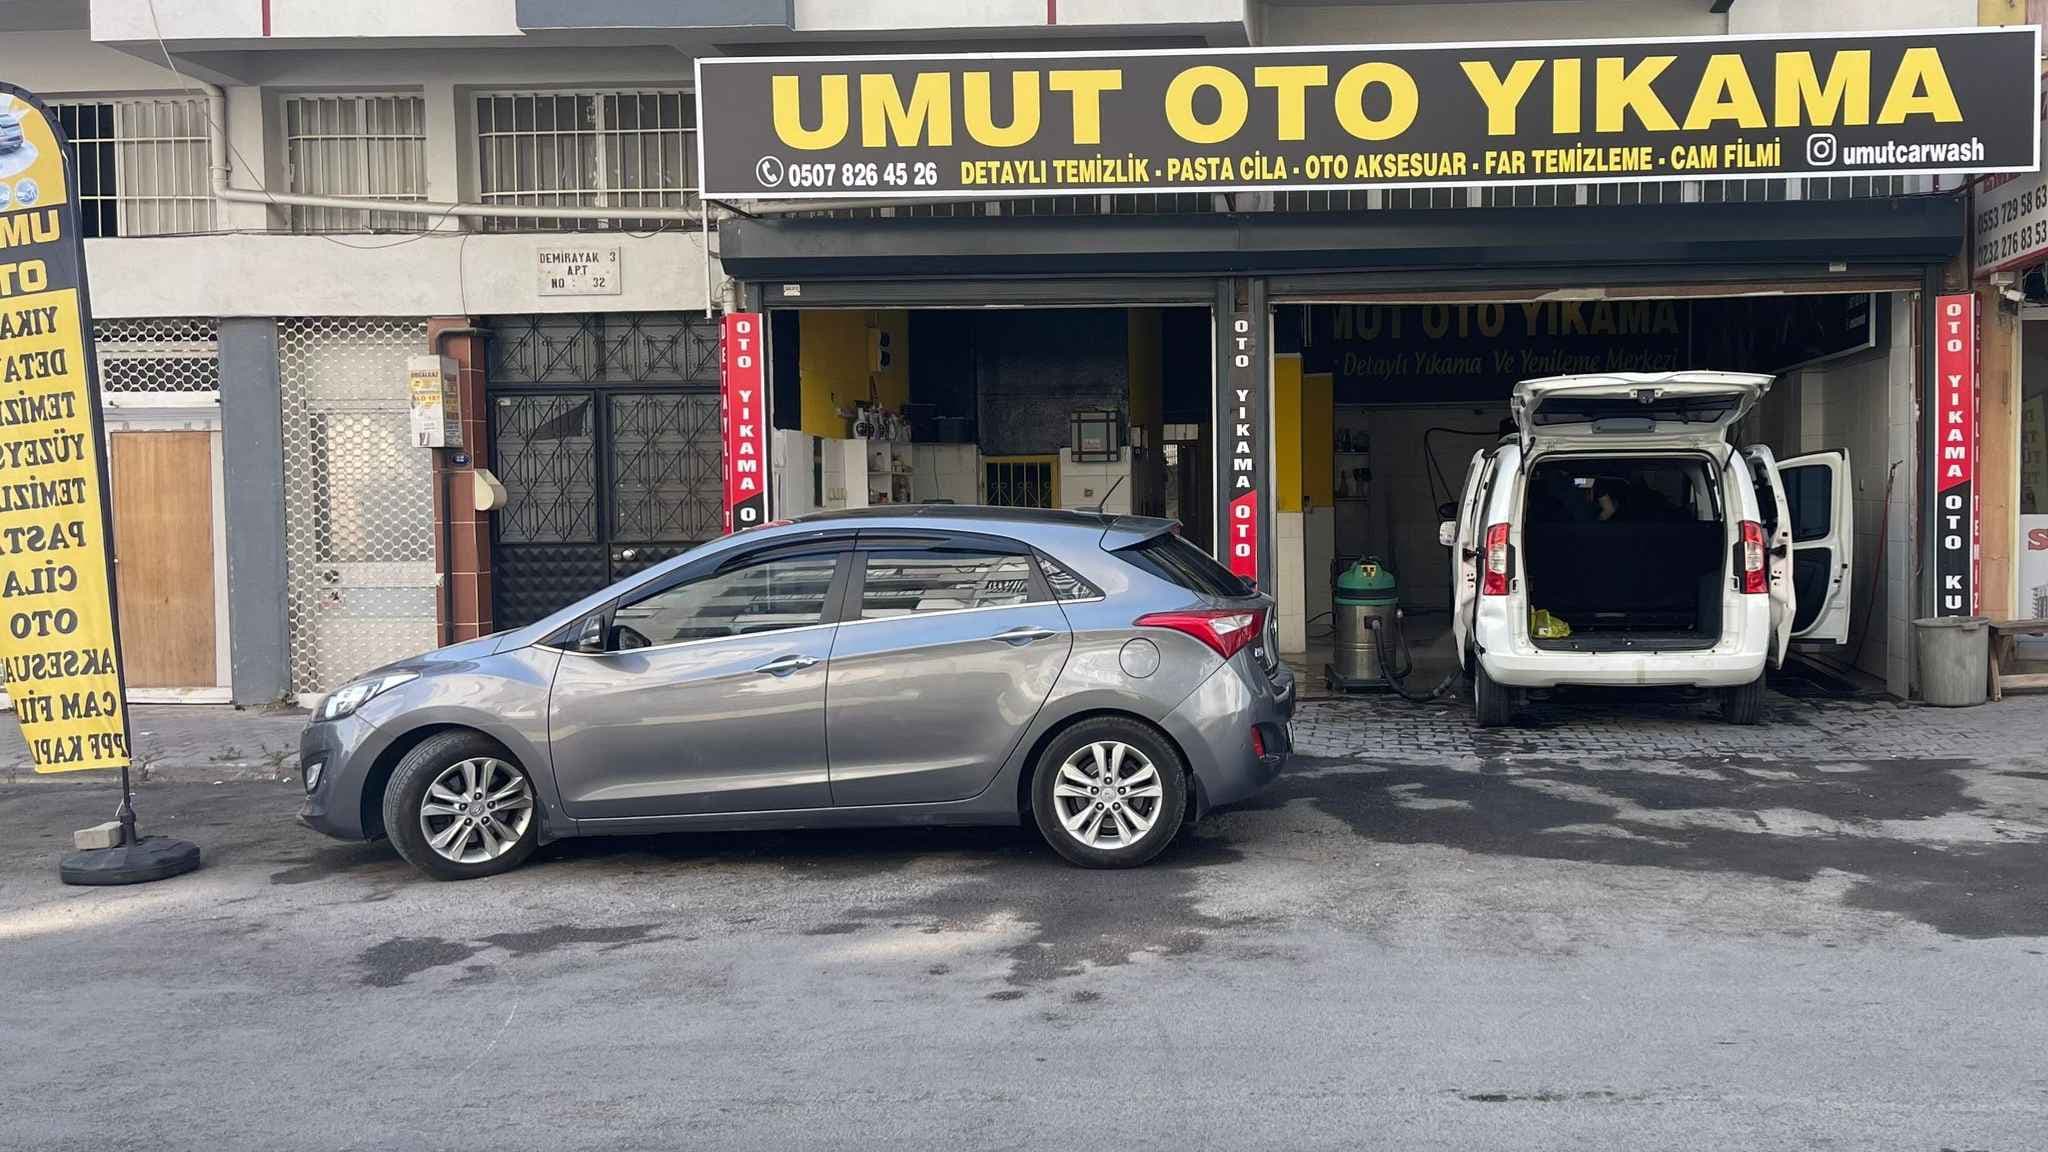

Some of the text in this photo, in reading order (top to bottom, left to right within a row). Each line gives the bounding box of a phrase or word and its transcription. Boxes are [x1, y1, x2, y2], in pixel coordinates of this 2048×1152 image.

[771, 47, 1964, 151] UMUT OTO YIKAMA
[960, 160, 1047, 185] DETAYLI
[1052, 152, 1149, 184] TEMİZLİK
[1167, 157, 1234, 181] PASTA
[1240, 150, 1287, 180] CİLA
[1305, 155, 1349, 180] OTO
[1355, 152, 1467, 178] AKSESUAR
[1485, 150, 1526, 174] FAR
[1531, 142, 1653, 173] TEMİZLEME
[1670, 144, 1718, 170] CAM
[1724, 137, 1781, 167] FİLMİ
[1843, 136, 1985, 166] umutcarwash
[789, 161, 938, 188] 0507 826 45 26
[2002, 198, 2018, 224] 729
[2021, 191, 2032, 216] 58
[2036, 184, 2047, 210] 63
[609, 251, 616, 262] 3
[2002, 231, 2018, 258] 276
[2021, 225, 2032, 250] 83
[2036, 219, 2047, 245] 53
[551, 278, 565, 288] NO
[593, 277, 606, 288] 32
[1421, 302, 1505, 338] OTO
[1520, 300, 1680, 337] YIKAMA
[1493, 348, 1515, 375] Ve
[1519, 346, 1601, 374] Yenileme
[1605, 343, 1680, 372] Merkezi
[736, 321, 757, 490] OTO YIKAMA
[1233, 319, 1253, 489] OTO YIKAMA
[1944, 303, 1966, 478] OTO YIKAMA
[1235, 504, 1251, 558] OTO
[1945, 494, 1963, 617] OTO KU
